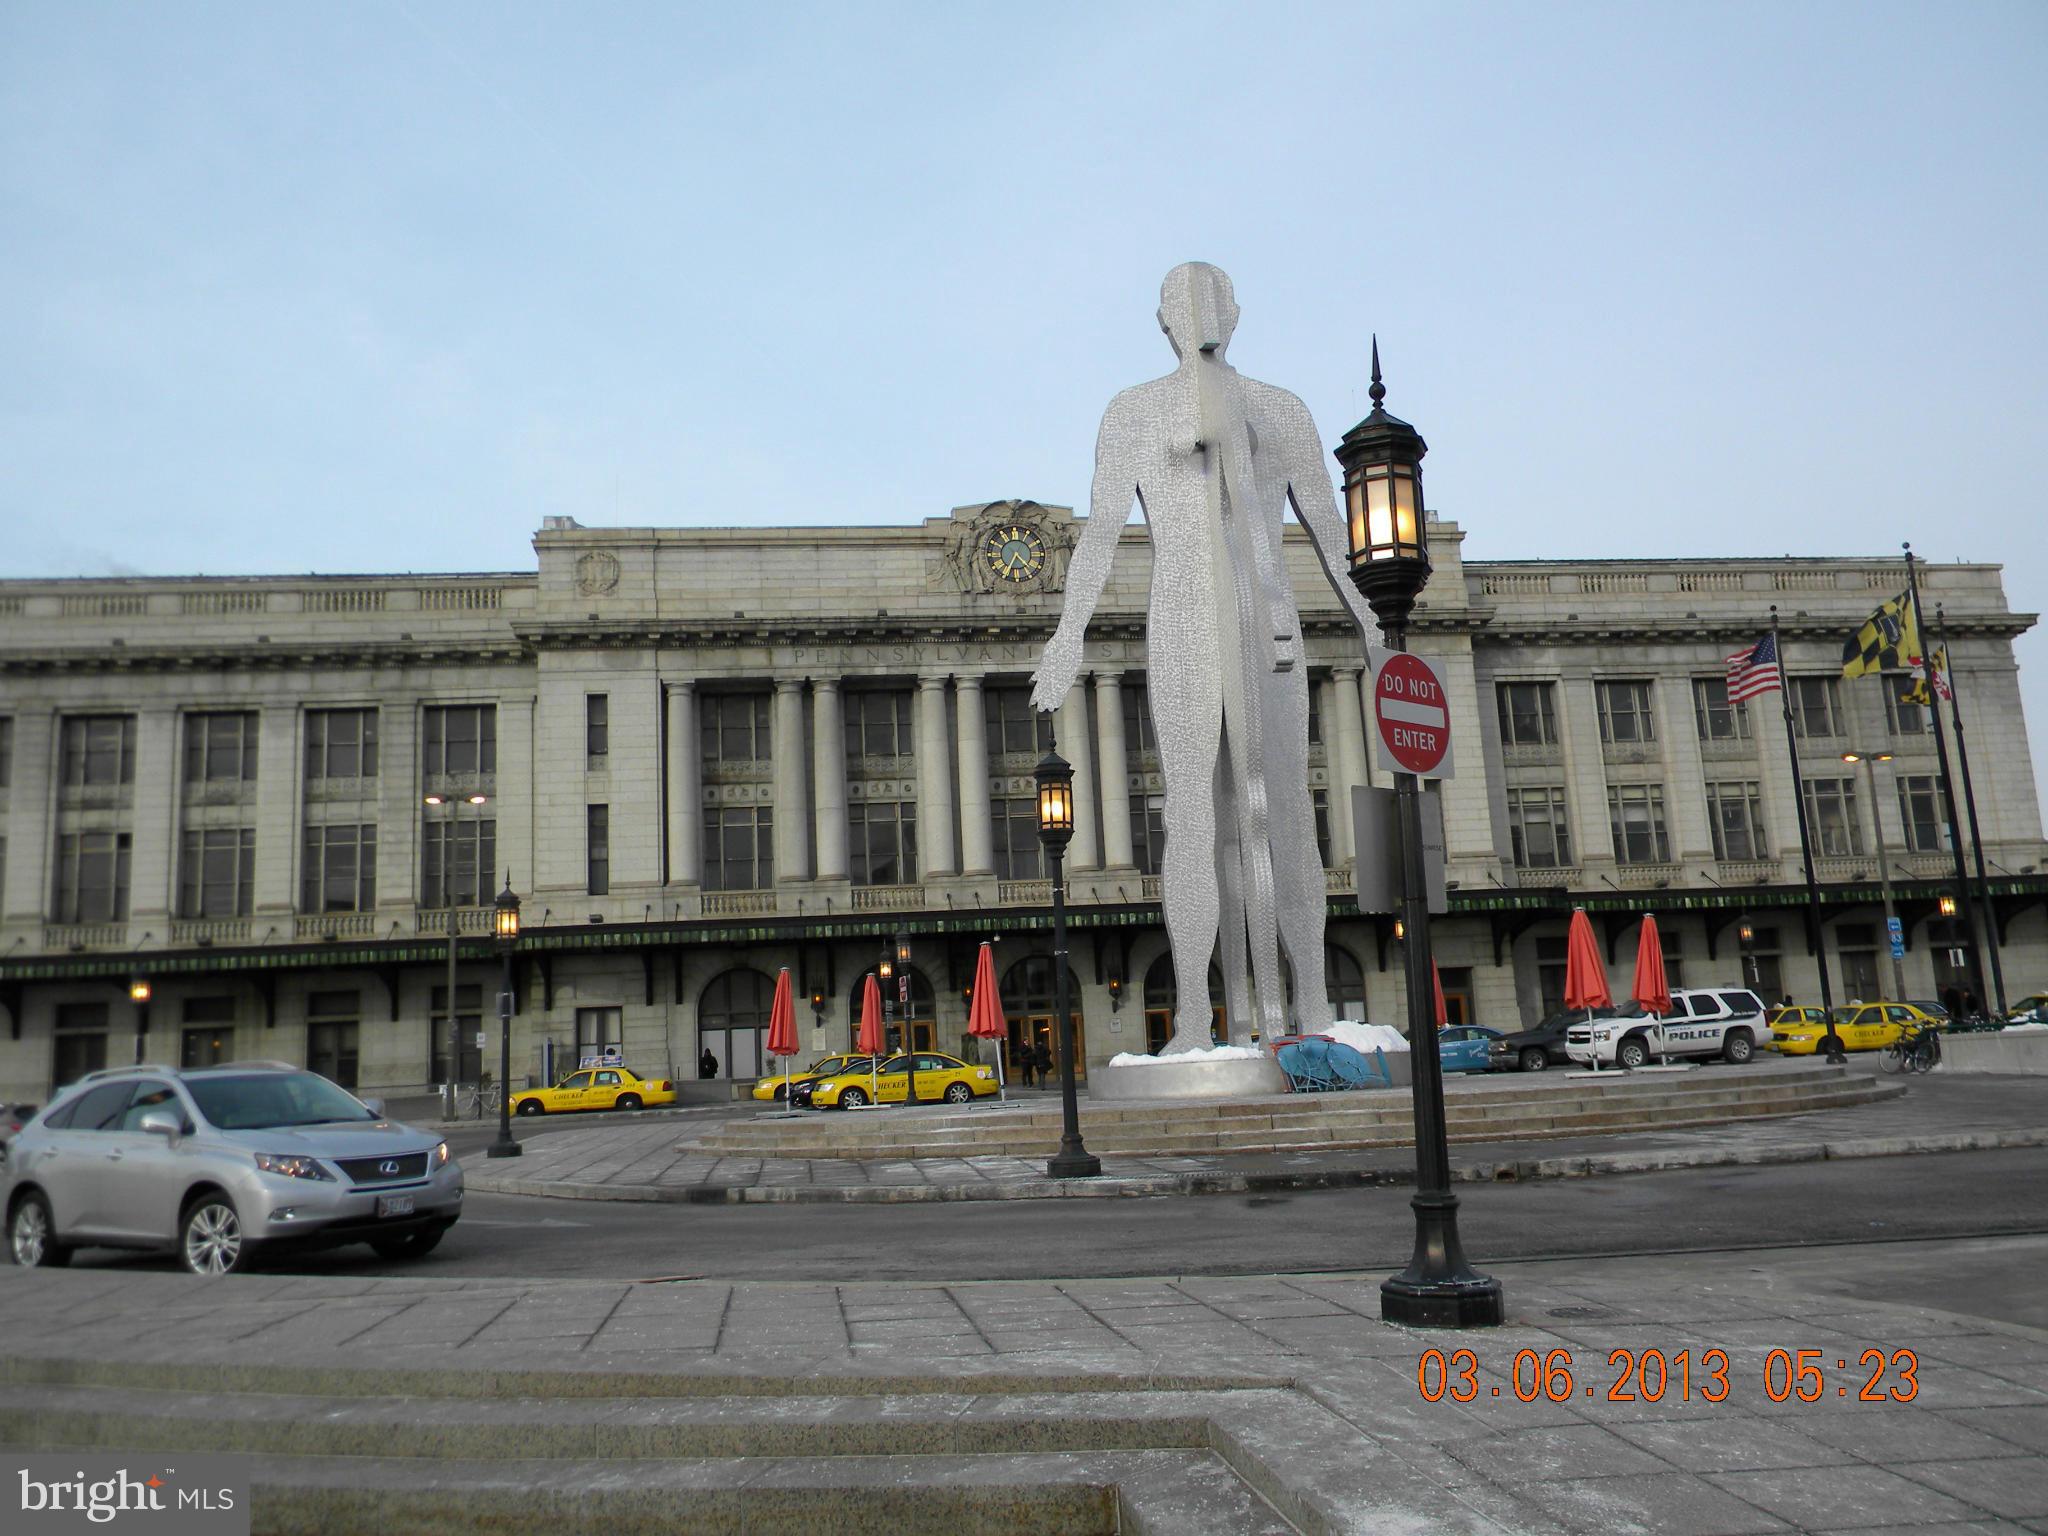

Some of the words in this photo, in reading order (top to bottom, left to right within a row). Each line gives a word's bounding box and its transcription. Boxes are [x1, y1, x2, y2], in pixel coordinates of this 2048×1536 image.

[794, 645, 1034, 663] PENNSYLVANI
[1384, 673, 1403, 693] DO
[1409, 679, 1436, 700] NOT
[1394, 728, 1436, 751] ENTER
[1669, 1029, 1720, 1041] POLICE
[877, 1082, 906, 1090] HECKER
[553, 1092, 584, 1100] CHECKER
